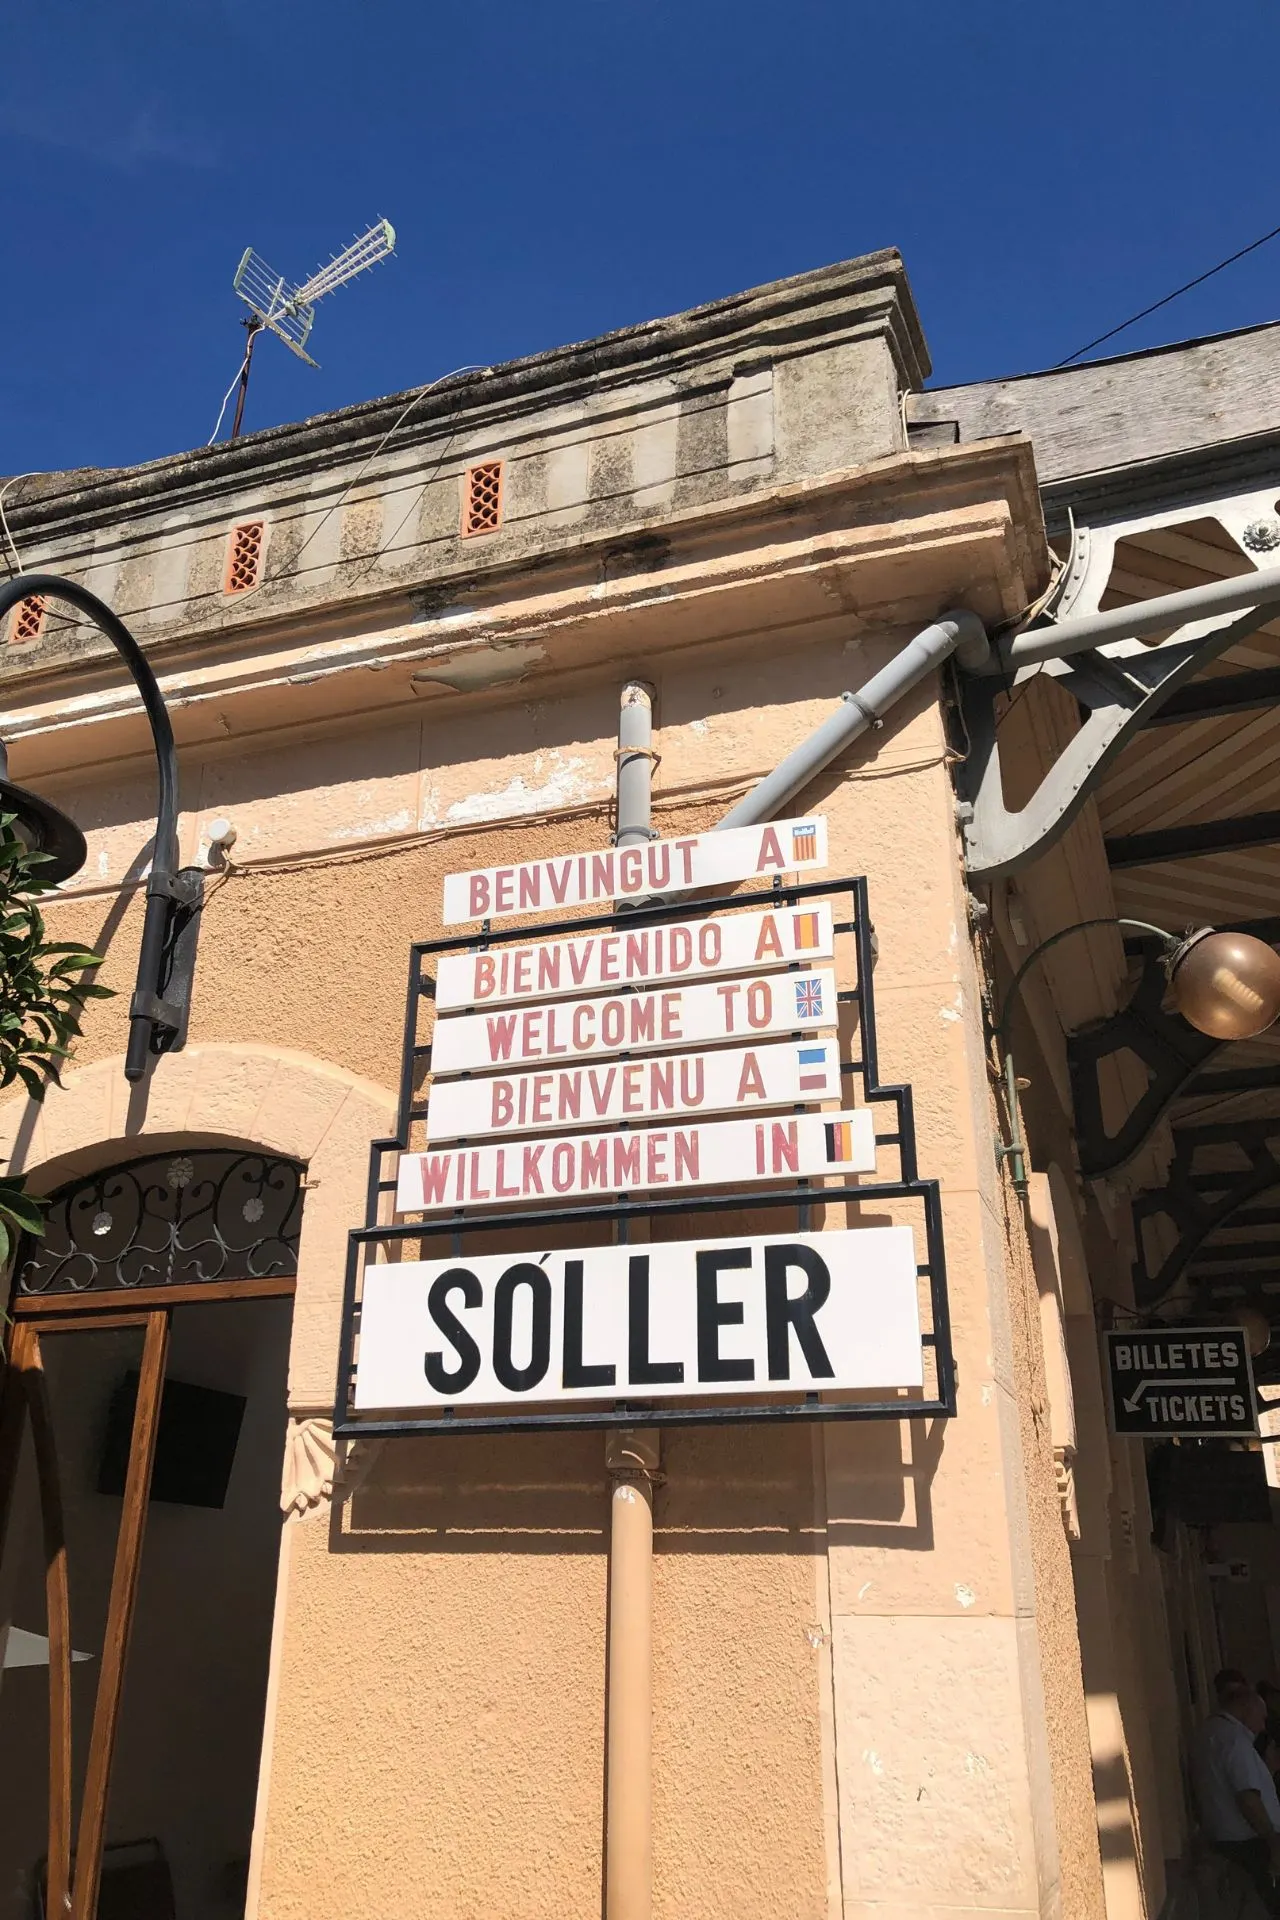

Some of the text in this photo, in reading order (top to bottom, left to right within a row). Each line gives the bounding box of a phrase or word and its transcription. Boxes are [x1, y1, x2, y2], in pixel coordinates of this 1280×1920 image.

[469, 827, 786, 917] BENVINGUT A
[474, 915, 784, 1000] BIENVENIDO A
[487, 981, 773, 1062] WELCOME TO
[492, 1052, 767, 1128] BIENVENU A
[421, 1121, 800, 1205] WILLKOMMEN IN
[424, 1244, 836, 1396] SÓLLER
[1115, 1342, 1239, 1371] BILLETES
[1146, 1395, 1246, 1422] TICKETS
